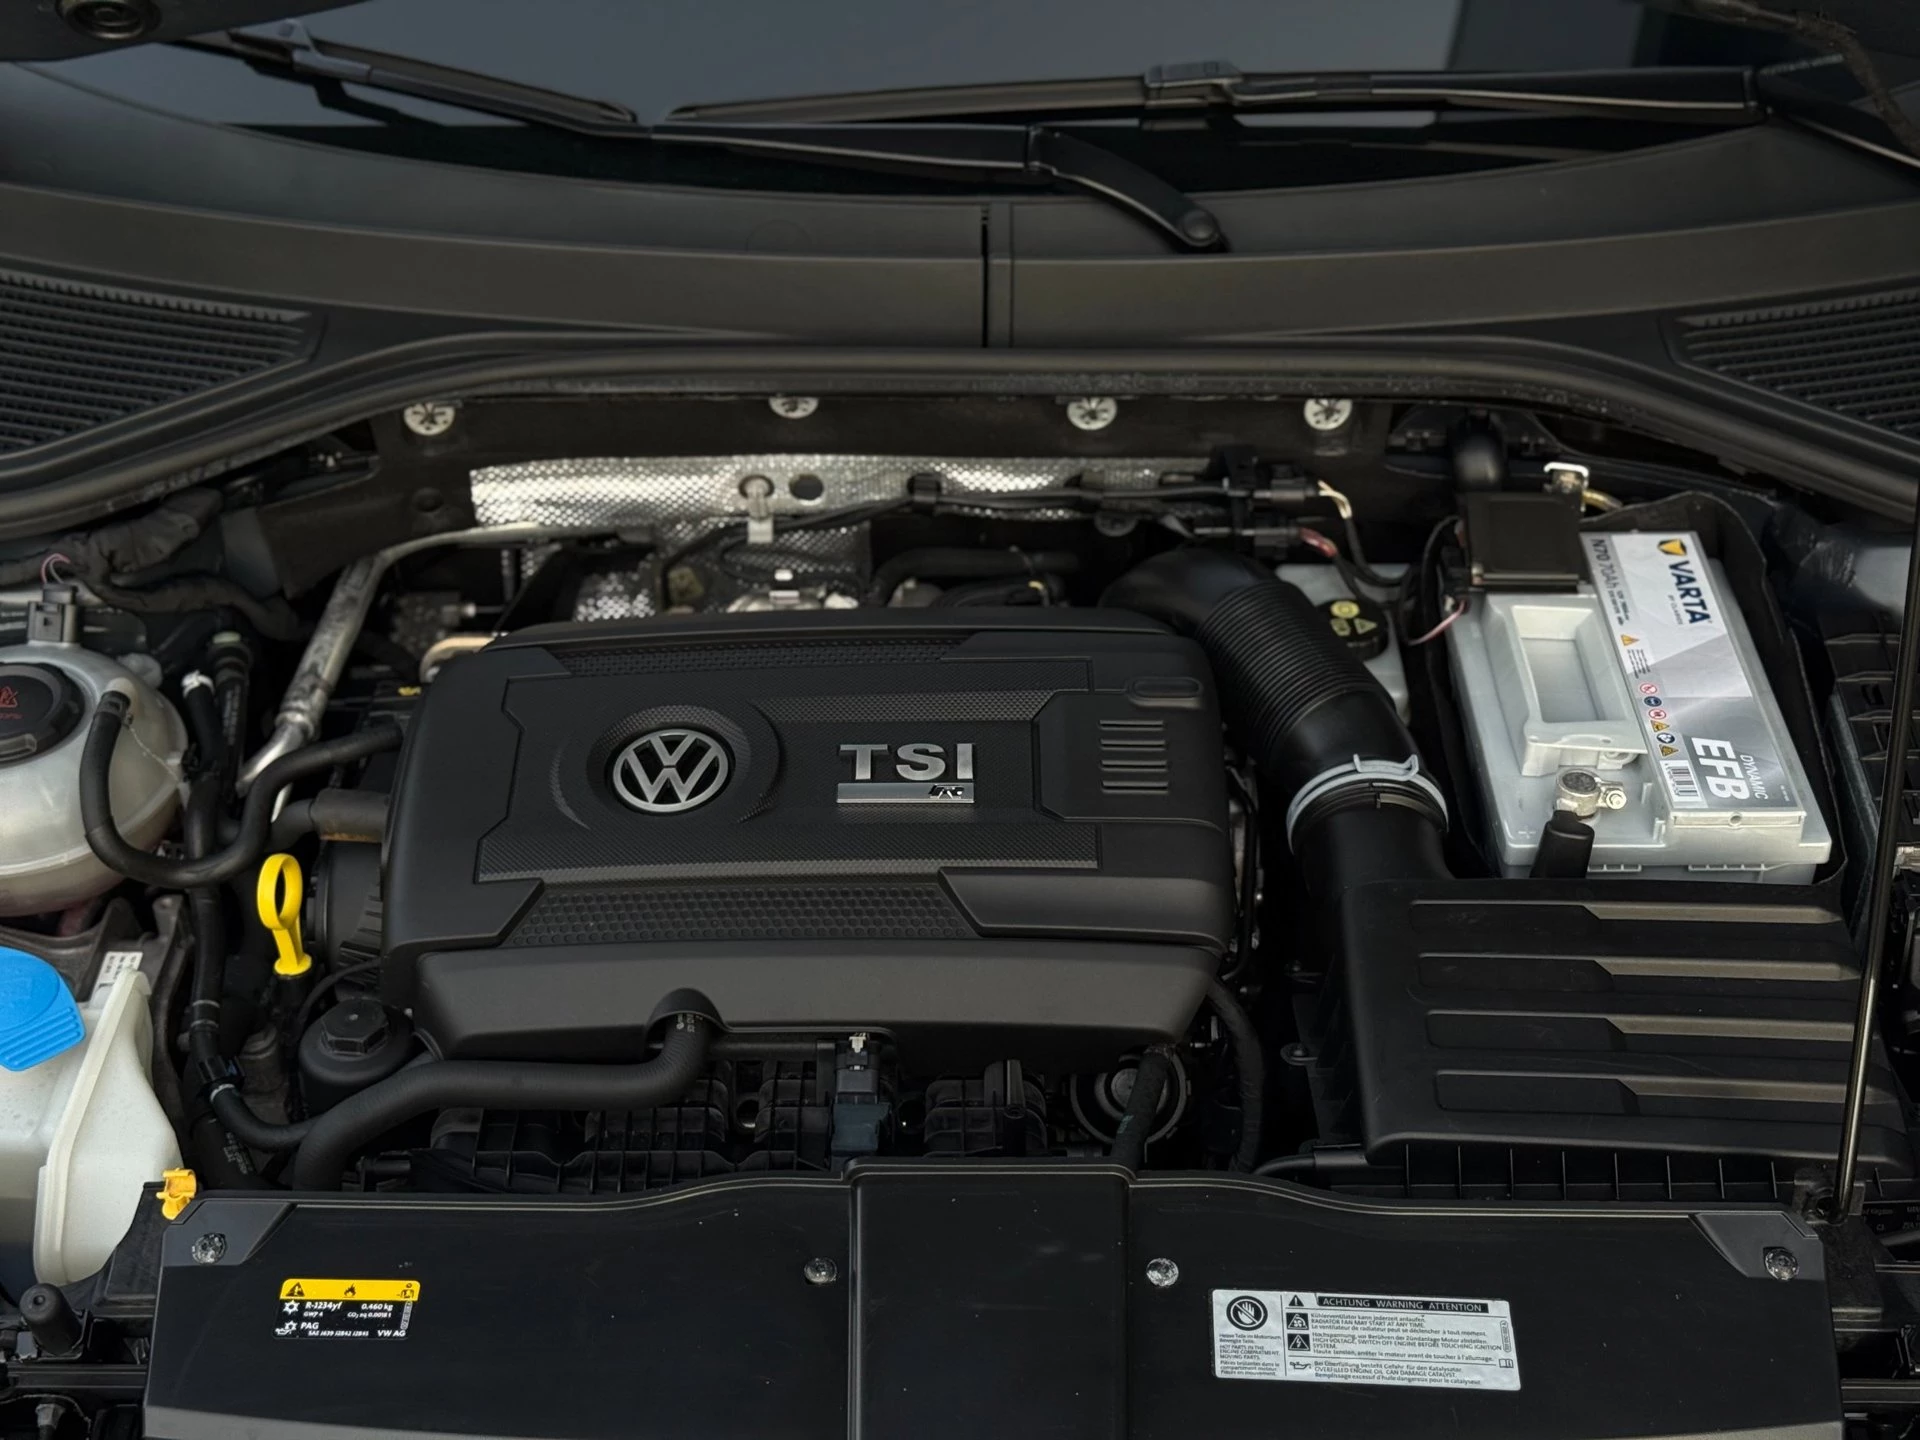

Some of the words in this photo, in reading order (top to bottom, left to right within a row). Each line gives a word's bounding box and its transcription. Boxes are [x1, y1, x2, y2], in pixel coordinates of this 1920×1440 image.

[1668, 560, 1711, 624] VARTA
[838, 743, 974, 781] TSI
[1691, 737, 1750, 800] EFB
[1740, 754, 1769, 800] DYNAMIC
[384, 1303, 394, 1311] kg
[1322, 1298, 1370, 1307] ACHTUNG
[1375, 1300, 1424, 1309] WARNING
[1429, 1302, 1482, 1312] ATTENTION
[300, 1321, 320, 1330] PAG
